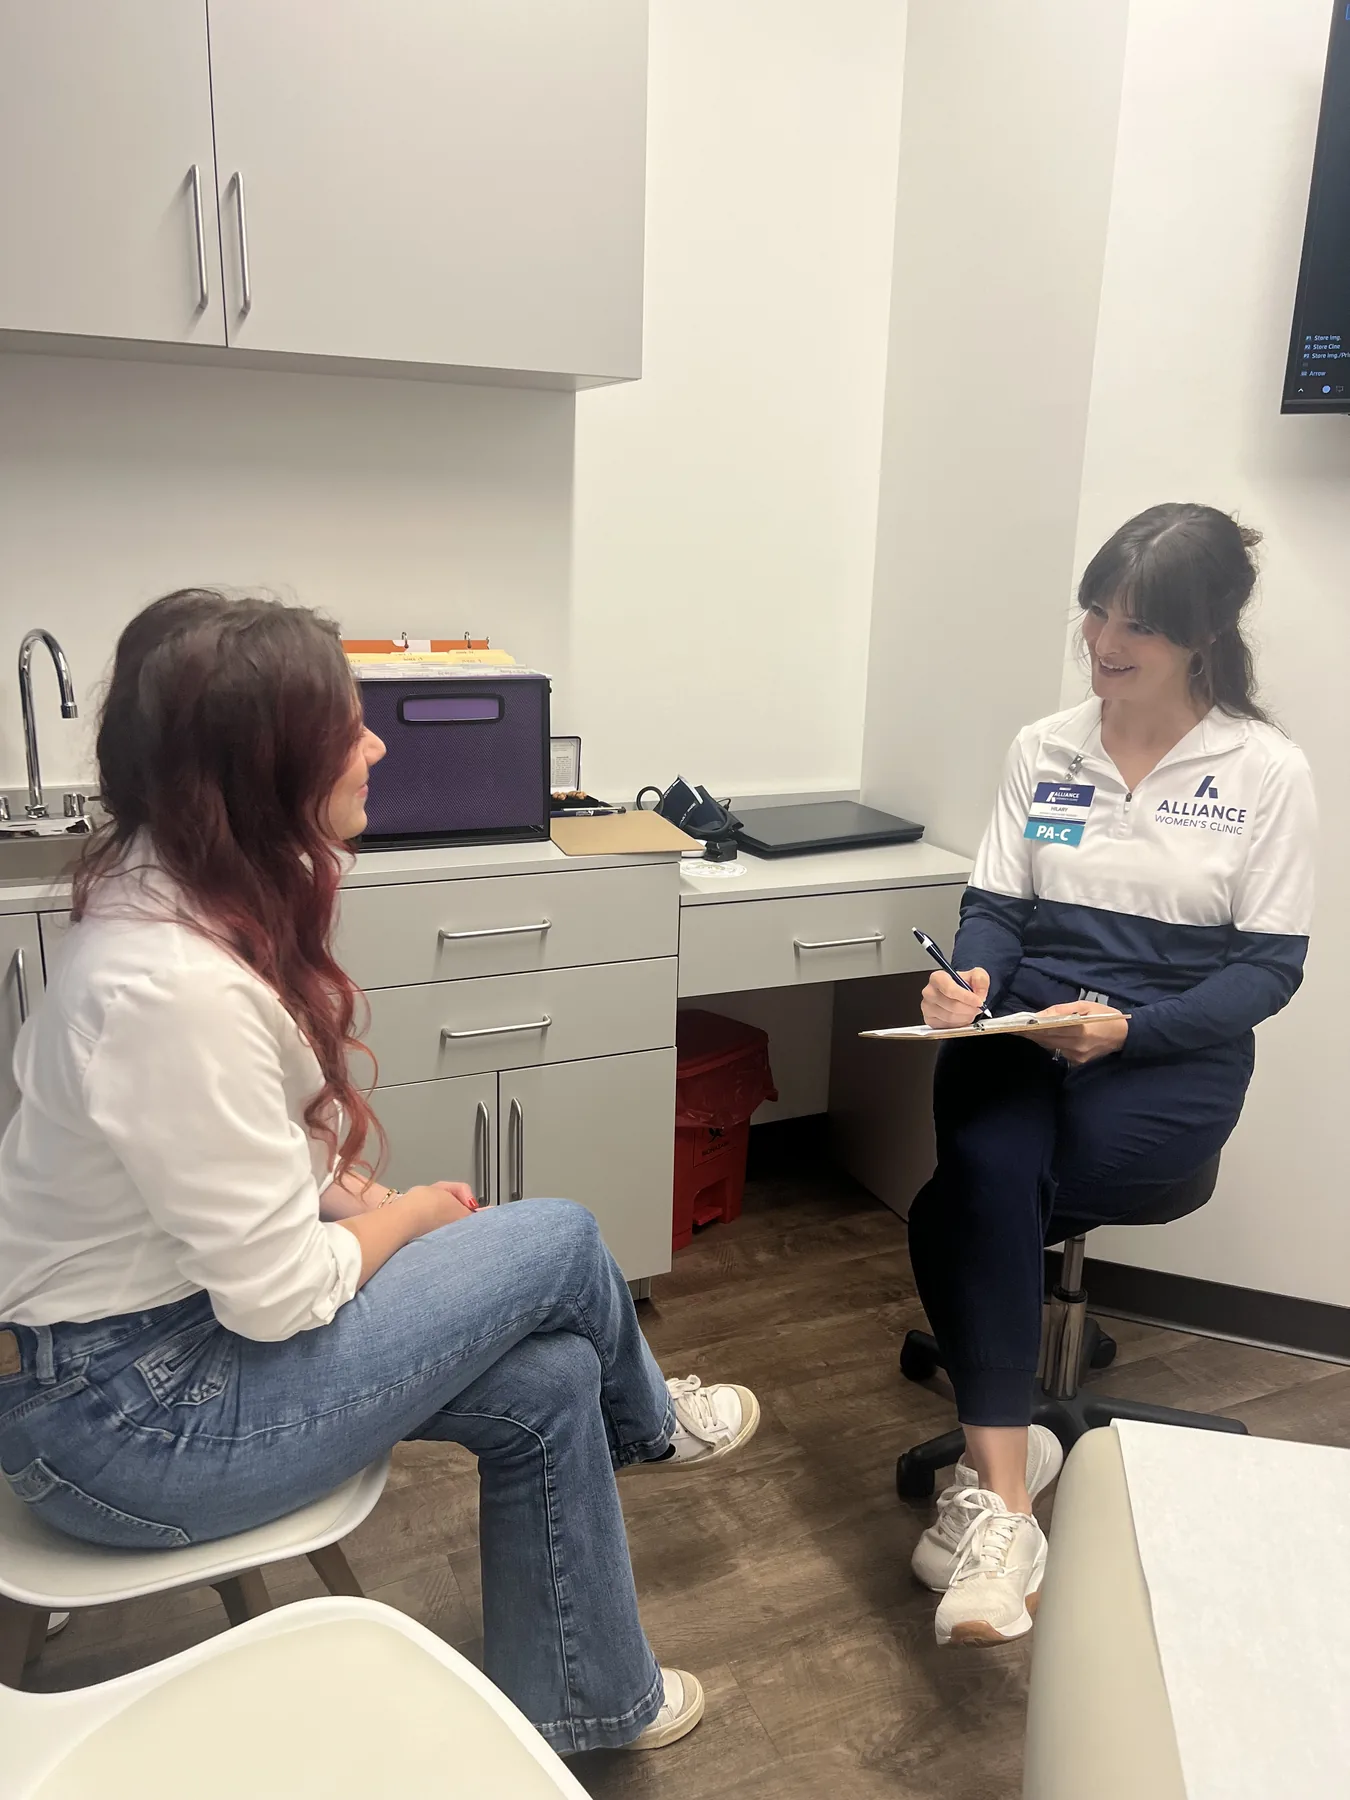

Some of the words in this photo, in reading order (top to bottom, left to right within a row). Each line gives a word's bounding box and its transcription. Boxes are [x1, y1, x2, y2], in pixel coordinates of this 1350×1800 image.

[1054, 791, 1080, 799] ALLIANCE
[1157, 799, 1247, 823] ALLIANCE
[1036, 825, 1072, 841] PA-C
[1154, 814, 1207, 829] WOMEN'S
[1209, 821, 1243, 835] CLINIC
